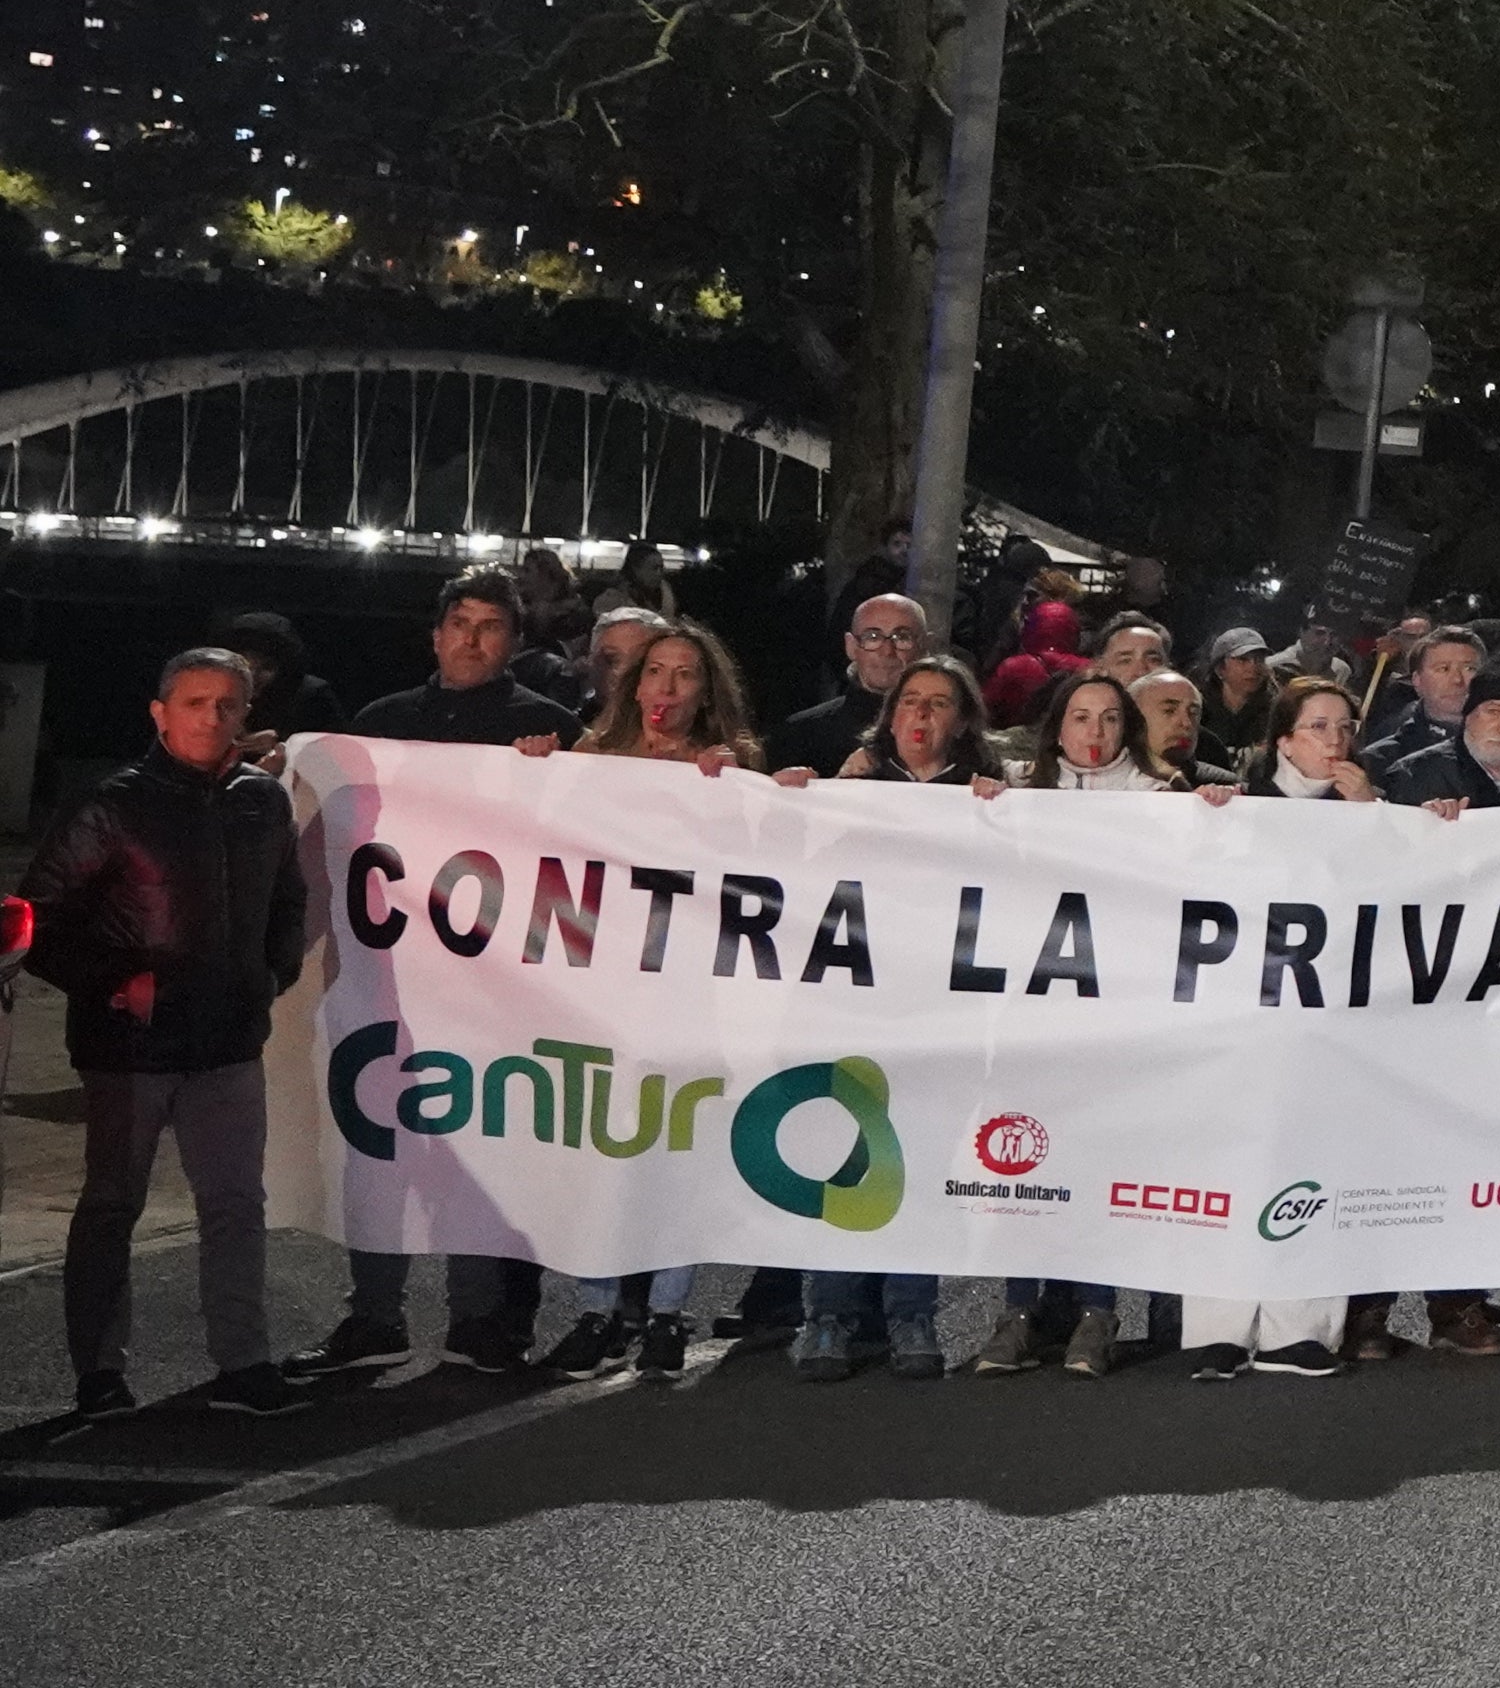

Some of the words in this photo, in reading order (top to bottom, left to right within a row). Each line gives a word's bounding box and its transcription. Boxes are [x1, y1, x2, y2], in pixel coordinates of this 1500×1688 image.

[346, 842, 875, 988] CONTRA
[949, 886, 1100, 998] LA
[945, 1179, 1010, 1199] Sindicato
[1014, 1183, 1071, 1202] Unitario
[1109, 1181, 1232, 1218] CCOO
[1342, 1188, 1392, 1199] CENTRAL
[1272, 1197, 1329, 1222] CSIF
[1340, 1200, 1435, 1214] INDEPENDIENTE
